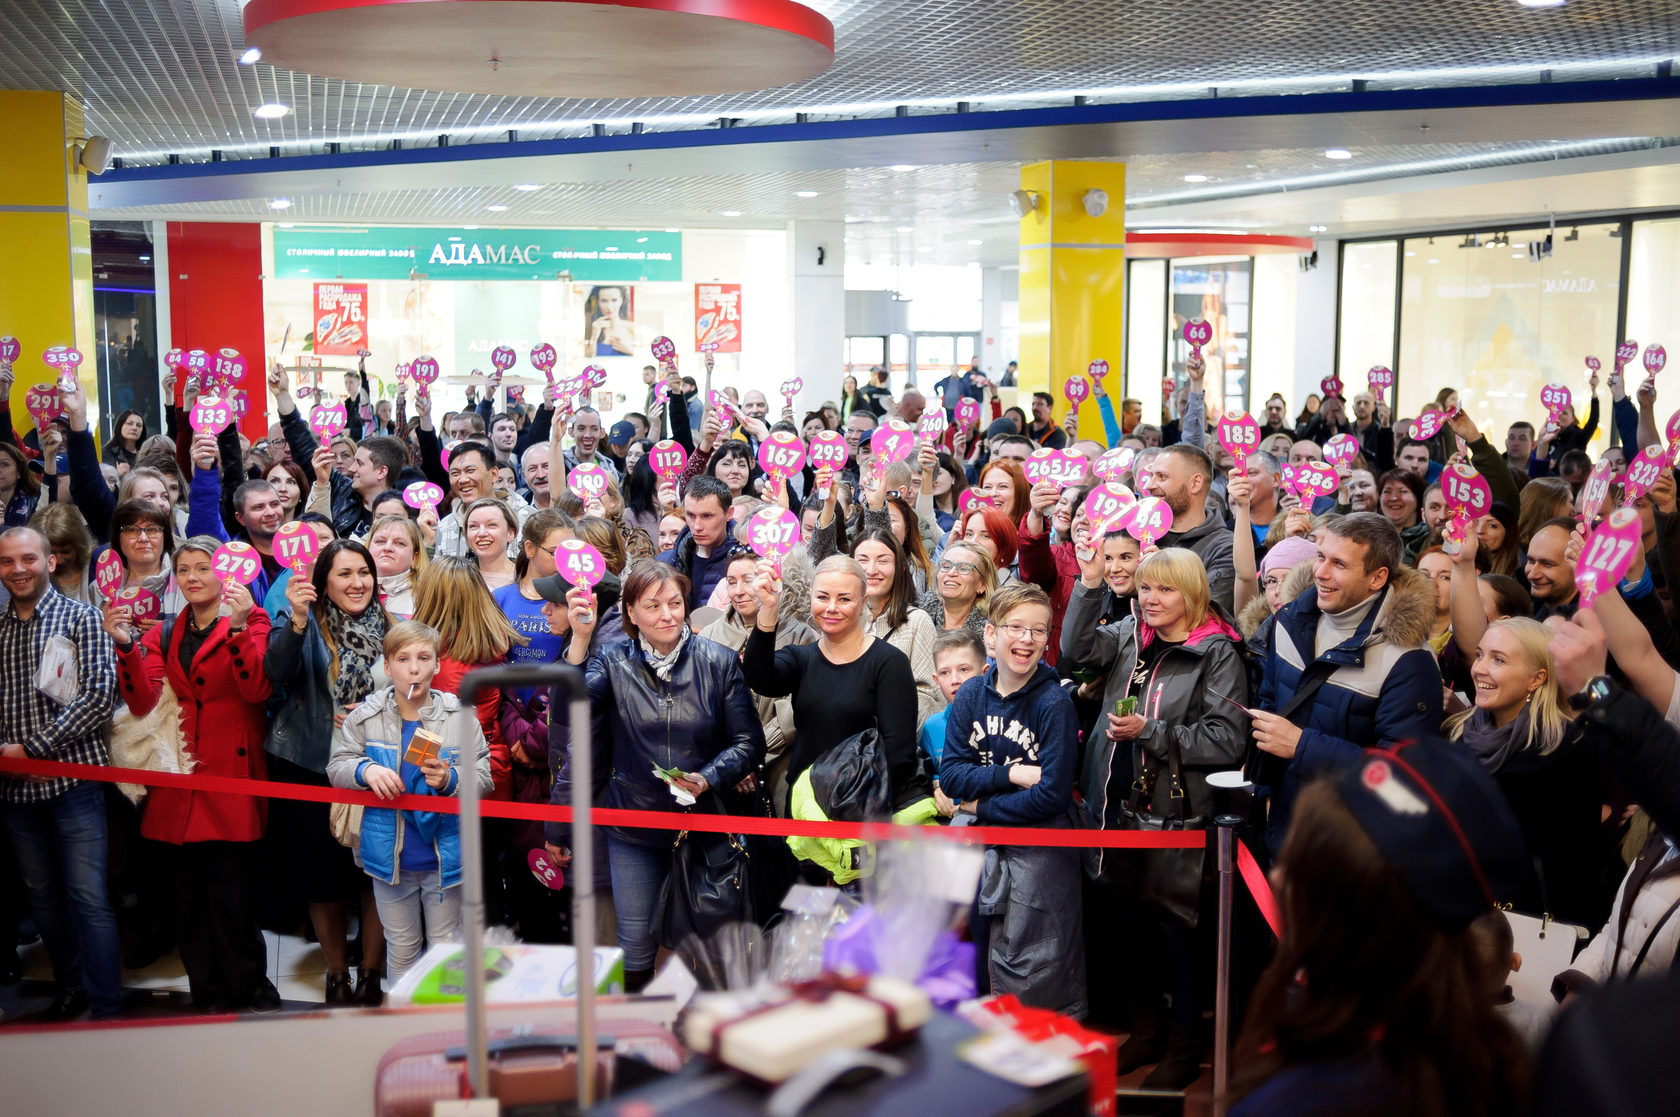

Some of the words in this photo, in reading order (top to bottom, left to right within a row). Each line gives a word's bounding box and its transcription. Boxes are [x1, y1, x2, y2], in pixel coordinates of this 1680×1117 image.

[428, 242, 541, 267] АДАМАС
[1189, 327, 1207, 339] 66
[2, 344, 15, 356] 17
[46, 352, 80, 363] 350
[495, 351, 513, 365] 141
[532, 349, 554, 366] 193
[653, 341, 673, 358] 333
[1616, 346, 1637, 359] 322
[188, 356, 206, 367] 58
[215, 358, 243, 378] 138
[1645, 352, 1664, 367] 164
[415, 363, 435, 377] 191
[587, 370, 602, 383] 96
[1369, 372, 1392, 383] 285
[555, 379, 583, 393] 324
[1069, 384, 1084, 396] 89
[30, 394, 59, 409] 291
[1543, 390, 1568, 405] 351
[196, 409, 227, 424] 133
[314, 411, 343, 427] 274
[960, 405, 974, 417] 61
[920, 418, 943, 433] 260
[1421, 413, 1435, 437] 349
[885, 434, 900, 452] 4
[1223, 424, 1256, 445] 185
[766, 444, 801, 468] 167
[813, 443, 845, 462] 293
[1330, 440, 1355, 459] 174
[656, 451, 682, 468] 112
[1028, 458, 1062, 478] 265
[1297, 469, 1333, 490] 286
[1629, 460, 1659, 487] 323
[409, 487, 440, 503] 160
[1449, 476, 1485, 508] 153
[1587, 478, 1607, 502] 154
[752, 522, 796, 544] 307
[279, 535, 312, 558] 171
[1585, 534, 1634, 572] 127
[215, 553, 256, 576] 279
[567, 553, 595, 572] 45
[98, 560, 121, 588] 282
[511, 619, 552, 634] PARIS
[535, 856, 557, 882] 32
